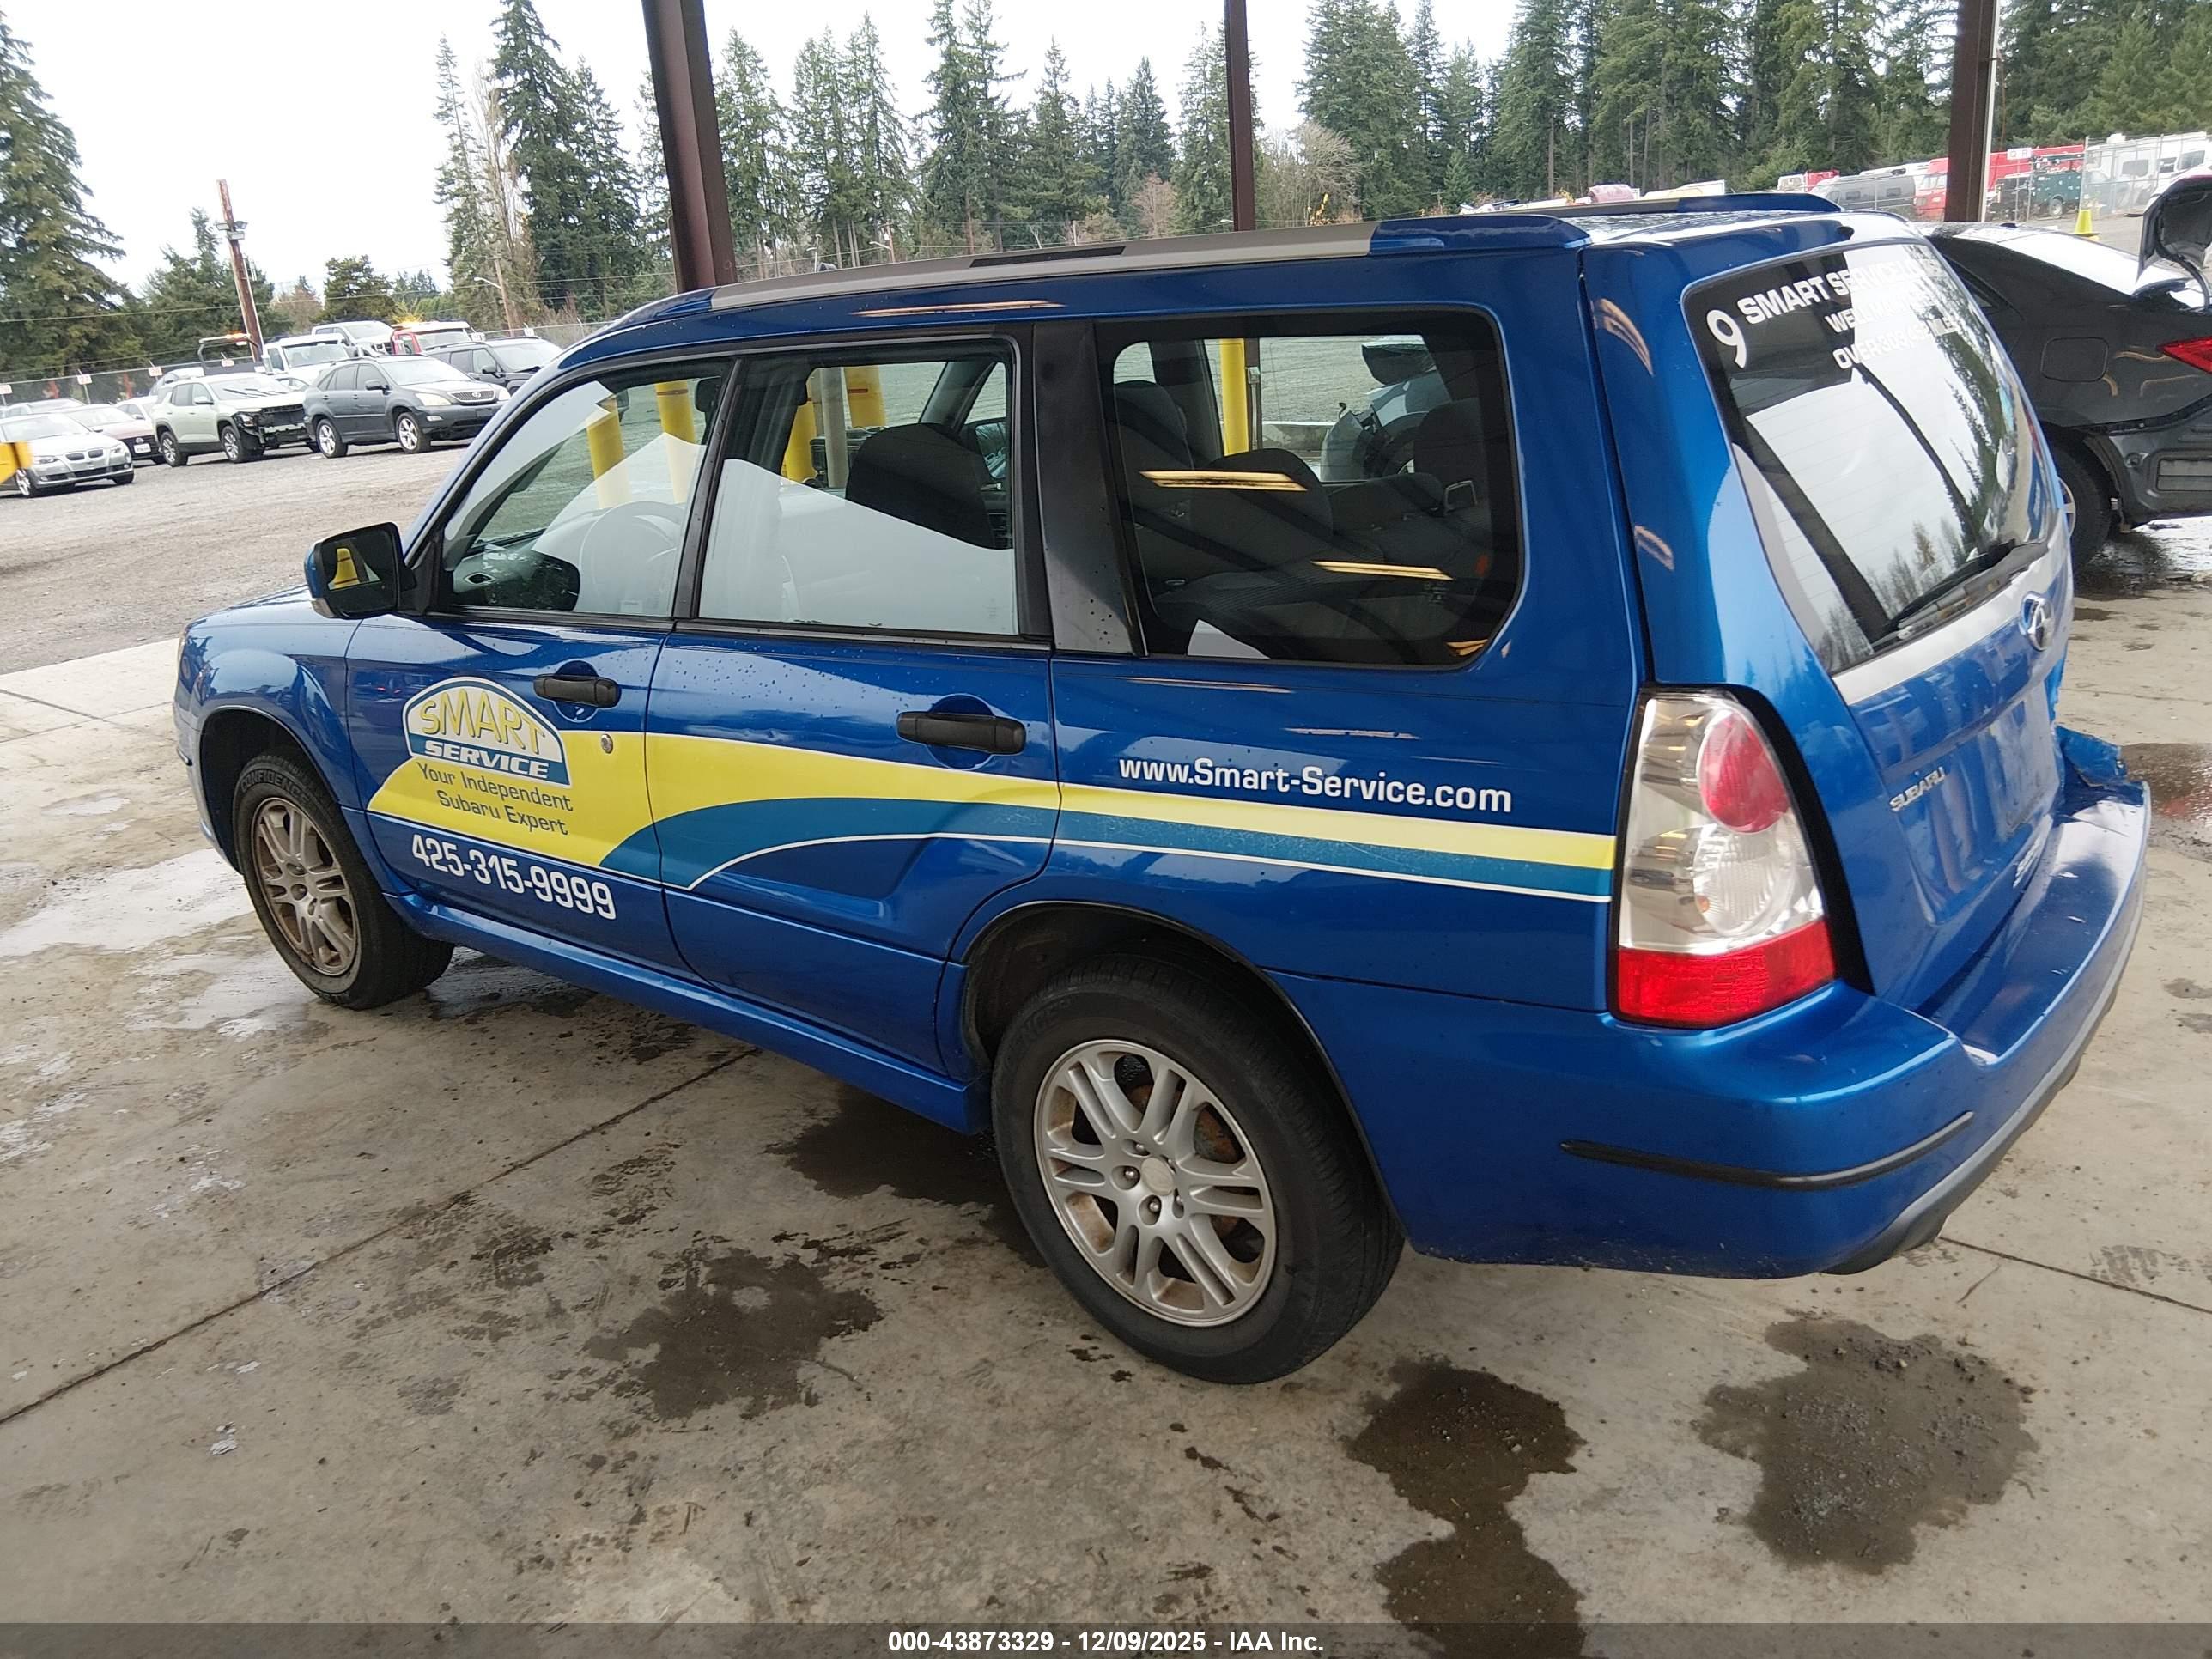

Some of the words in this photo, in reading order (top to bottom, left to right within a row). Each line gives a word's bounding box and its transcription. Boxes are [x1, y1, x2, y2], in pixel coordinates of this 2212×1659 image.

[1736, 275, 1833, 325] SMART
[1706, 309, 1747, 369] 9
[1832, 337, 1882, 370] OVER
[421, 689, 544, 756] SMART
[424, 739, 549, 779] SERVICE
[418, 762, 455, 785] Your
[463, 769, 574, 812] Independent
[1119, 757, 1511, 813] www.Smart-Service.com
[1890, 766, 1946, 811] SUBARU
[436, 790, 501, 820] Subaru
[509, 807, 568, 836] Expert
[411, 833, 617, 920] 425-315-9999
